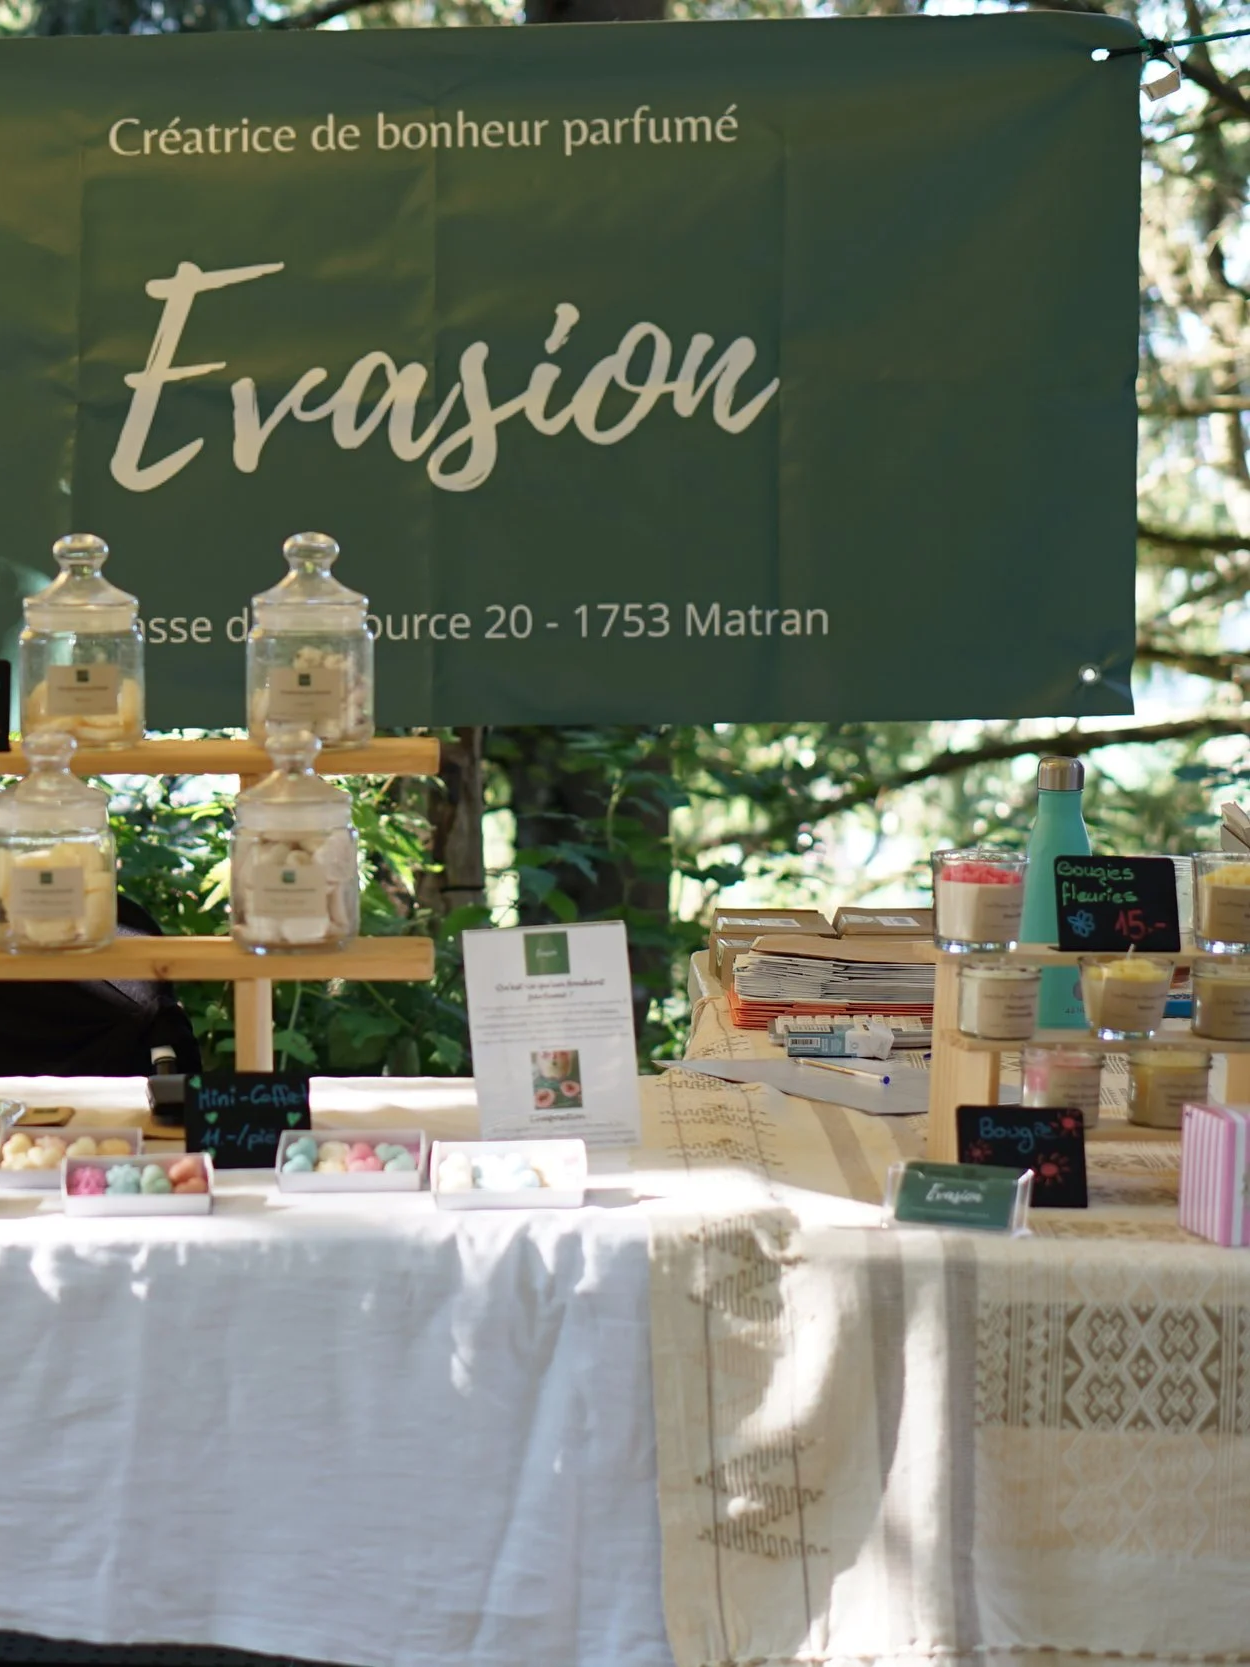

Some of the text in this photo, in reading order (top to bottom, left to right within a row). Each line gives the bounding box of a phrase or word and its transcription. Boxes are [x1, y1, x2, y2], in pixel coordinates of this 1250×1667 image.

[108, 103, 740, 156] Créatrice de bonheur parfumé
[110, 260, 781, 492] Evasion
[136, 601, 830, 644] sse d ource 20 - 1753 Matran
[1056, 860, 1135, 887] Bougies
[1061, 880, 1139, 907] fleuries
[1115, 908, 1167, 941] 15.-
[925, 1182, 985, 1205] Evasion
